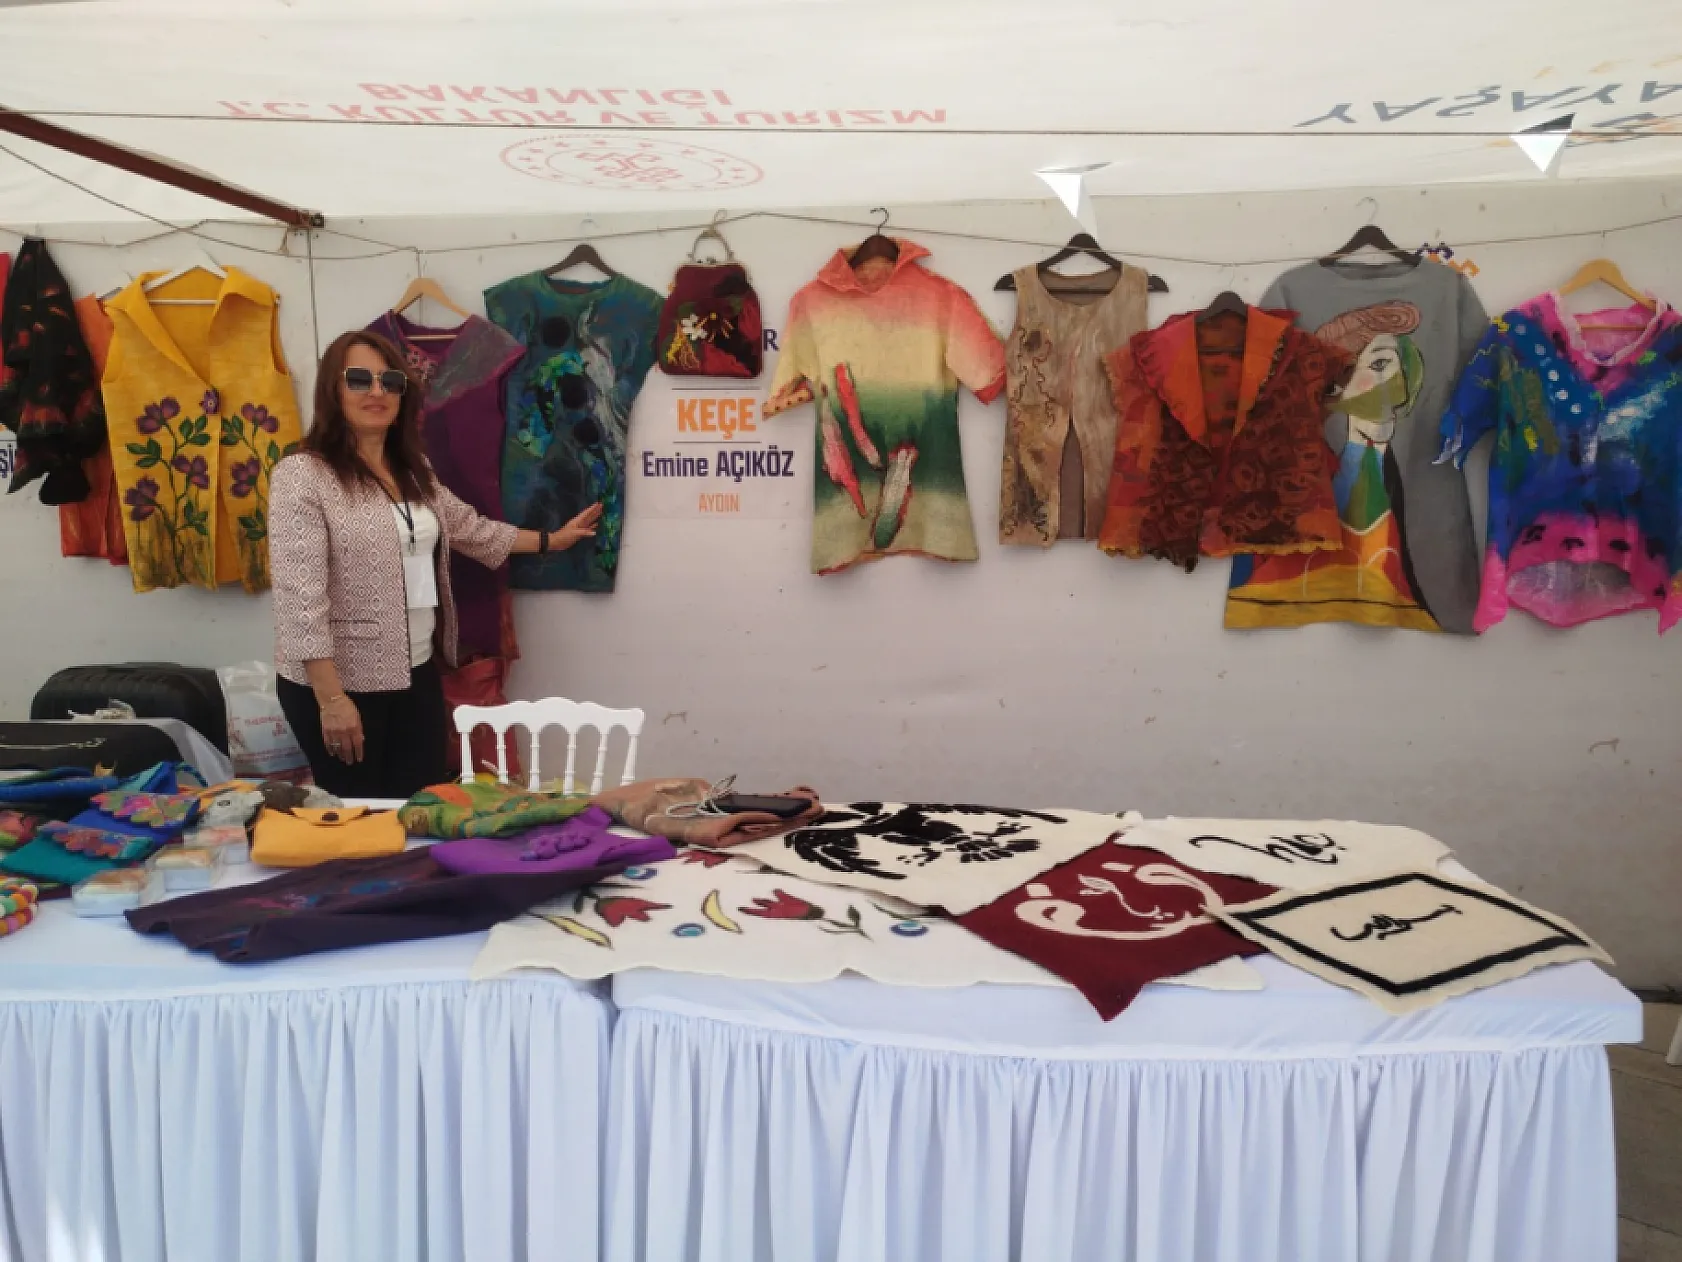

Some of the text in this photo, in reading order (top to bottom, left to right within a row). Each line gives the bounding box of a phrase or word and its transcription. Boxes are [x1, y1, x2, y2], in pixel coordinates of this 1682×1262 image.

[676, 398, 757, 440] KEÇE
[642, 445, 795, 483] Emine AÇIKÖZ
[699, 493, 741, 514] AYDIN
